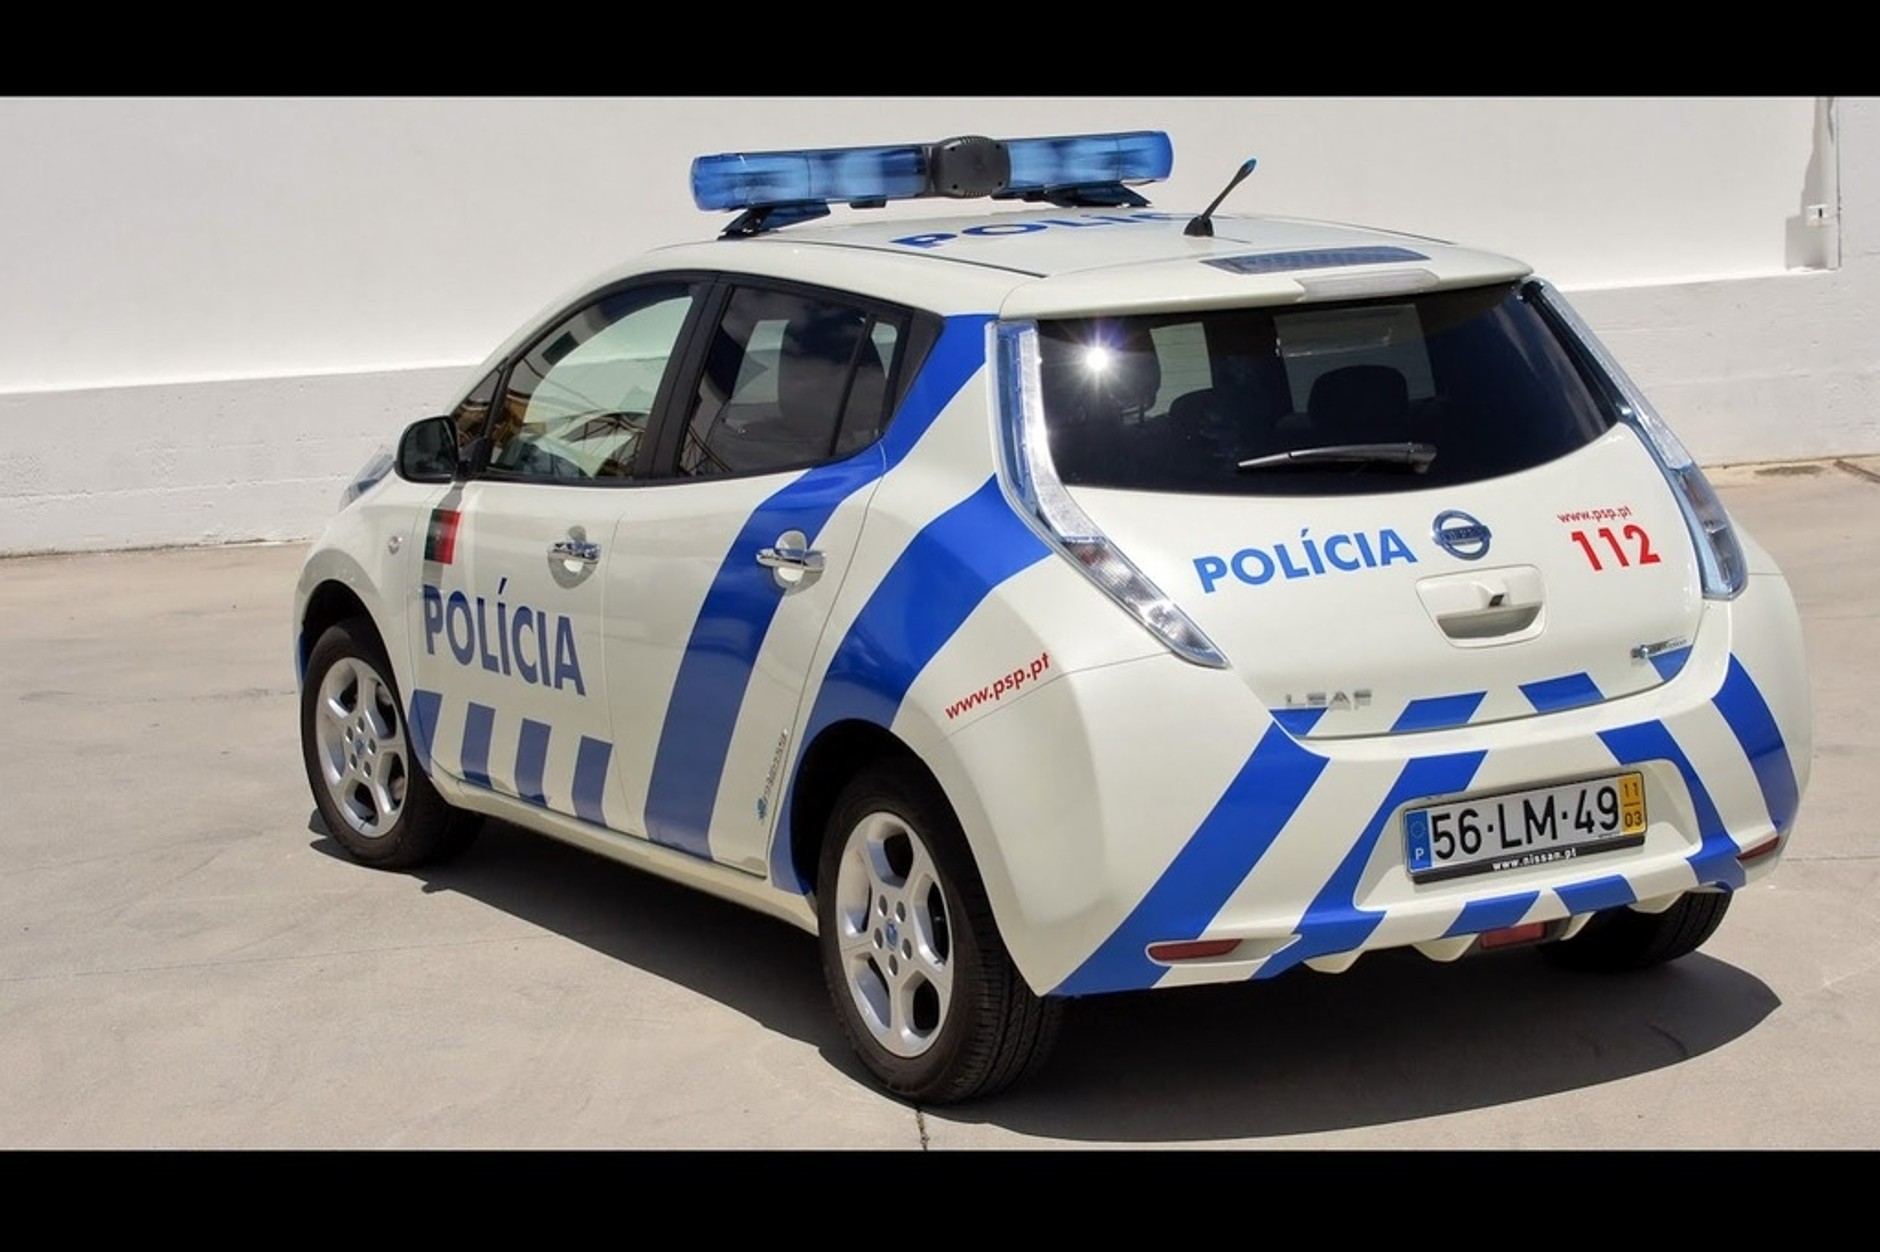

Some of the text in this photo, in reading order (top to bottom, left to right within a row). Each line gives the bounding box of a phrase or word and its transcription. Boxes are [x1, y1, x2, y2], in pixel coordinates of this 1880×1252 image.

[1557, 506, 1633, 523] www.psp.pt
[1571, 525, 1661, 571] 112
[1193, 528, 1418, 594] POLÍCIA
[422, 576, 586, 696] POLÍCIA
[945, 652, 1049, 719] www.psp.pt
[1624, 782, 1639, 798] 11
[1624, 811, 1643, 828] 03
[1415, 848, 1424, 861] P
[1492, 847, 1577, 871] www.nissan.pt
